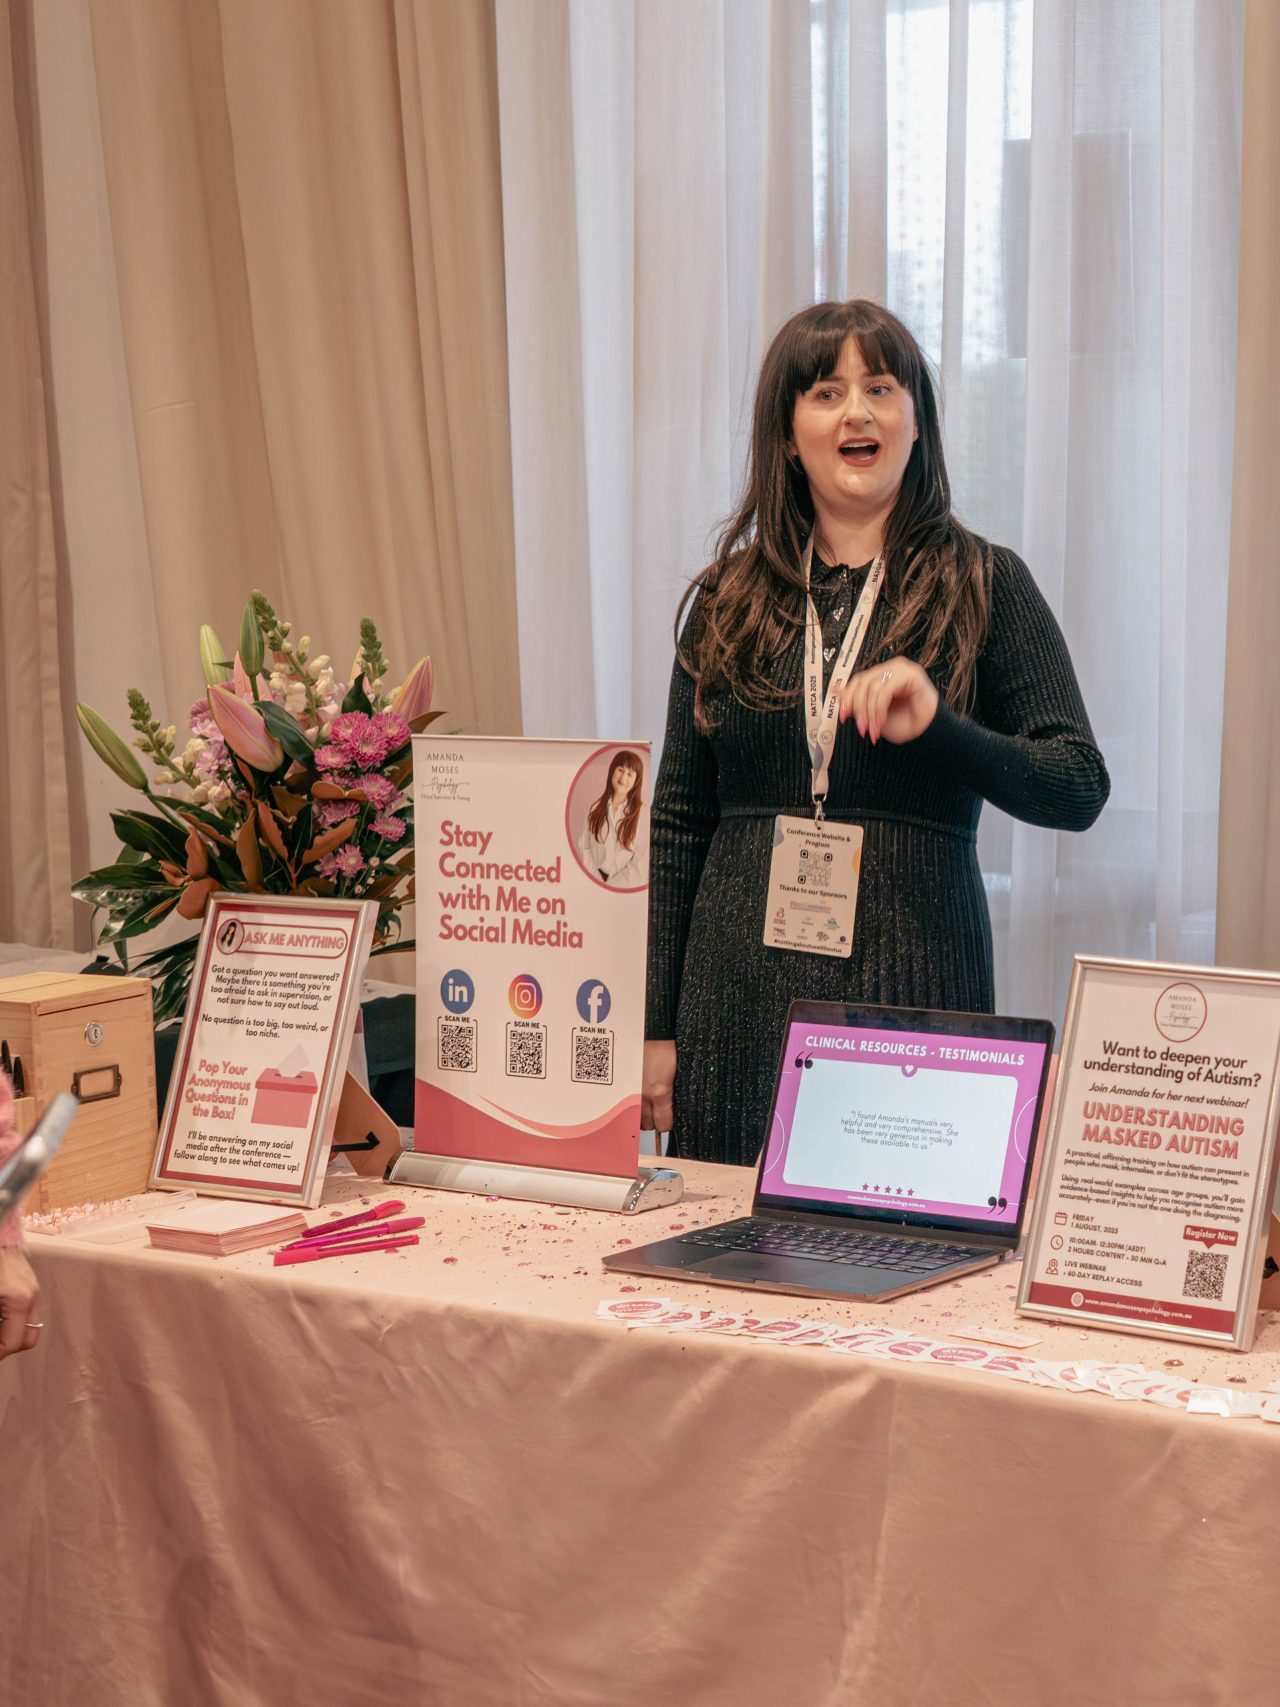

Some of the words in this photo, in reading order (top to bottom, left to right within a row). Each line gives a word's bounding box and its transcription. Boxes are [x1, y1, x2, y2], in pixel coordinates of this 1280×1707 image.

[827, 696, 837, 718] NATCA
[427, 753, 464, 762] AMANDA
[432, 766, 458, 774] MOSES
[439, 820, 493, 855] Stay
[787, 828, 820, 838] Conference
[822, 832, 845, 841] Website
[805, 840, 830, 848] Program
[438, 852, 561, 883] Connected
[438, 884, 490, 911] with
[496, 886, 530, 914] Me
[536, 897, 566, 916] on
[779, 884, 800, 893] Thanks
[820, 890, 848, 900] Sponsors
[438, 914, 506, 944] Social
[512, 918, 583, 948] Media
[244, 931, 268, 945] ASK
[270, 933, 286, 946] ME
[287, 934, 345, 950] ANYTHING
[212, 964, 224, 974] Got
[232, 967, 262, 976] question
[264, 970, 278, 980] you
[280, 970, 298, 978] want
[299, 972, 340, 982] answered?
[216, 975, 240, 986] Maybe
[242, 977, 260, 986] there
[269, 980, 306, 992] something
[307, 982, 331, 992] you're
[448, 978, 468, 1003] in
[210, 986, 222, 994] too
[224, 986, 246, 995] afraid
[248, 988, 255, 996] to
[256, 988, 268, 996] ask
[278, 991, 322, 1001] supervision,
[202, 1014, 212, 1022] No
[214, 1016, 244, 1026] question
[246, 1018, 251, 1026] is
[266, 1019, 280, 1029] big,
[282, 1021, 294, 1029] too
[295, 1022, 318, 1032] weird,
[462, 1016, 470, 1024] ME
[514, 1020, 530, 1028] SCAN
[246, 1028, 258, 1036] too
[259, 1029, 280, 1038] niche.
[580, 1026, 596, 1034] SCAN
[806, 1036, 856, 1051] CLINICAL
[860, 1042, 928, 1058] RESOURCES
[939, 1047, 1025, 1066] TESTIMONIALS
[1102, 1040, 1140, 1058] Want
[1144, 1046, 1156, 1060] to
[1160, 1047, 1210, 1067] deepen
[1214, 1056, 1248, 1070] your
[199, 1059, 219, 1076] Pop
[222, 1060, 248, 1076] Your
[1084, 1058, 1184, 1084] understanding
[1187, 1066, 1202, 1081] of
[1204, 1069, 1262, 1088] Autism?
[188, 1073, 250, 1091] Anonymous
[185, 1088, 236, 1106] Questions
[238, 1094, 248, 1106] in
[1088, 1082, 1108, 1094] Join
[1109, 1085, 1150, 1098] Amanda
[1152, 1090, 1166, 1100] for
[1167, 1090, 1182, 1101] her
[1184, 1094, 1204, 1103] next
[1206, 1097, 1249, 1108] webinar!
[192, 1104, 208, 1117] the
[211, 1106, 236, 1120] Box!
[1082, 1101, 1244, 1136] UNDERSTANDING
[188, 1130, 197, 1139] I'll
[198, 1132, 207, 1140] be
[208, 1135, 246, 1146] answering
[259, 1140, 271, 1148] my
[272, 1141, 294, 1150] social
[1082, 1123, 1162, 1150] MASKED
[1165, 1134, 1239, 1159] AUTISM
[186, 1142, 208, 1151] media
[210, 1144, 228, 1152] after
[229, 1146, 240, 1154] the
[242, 1148, 282, 1159] conference
[174, 1150, 196, 1159] follow
[198, 1152, 218, 1164] along
[242, 1158, 261, 1168] what
[262, 1162, 285, 1170] comes
[287, 1163, 300, 1172] up!
[1072, 1214, 1094, 1222] FRIDAY
[1104, 1226, 1118, 1234] 2025
[1186, 1228, 1217, 1240] Register
[1218, 1232, 1236, 1242] Now
[1100, 1241, 1124, 1250] 12:30PM
[1126, 1244, 1146, 1254] (AEDT)
[1064, 1260, 1078, 1268] LIVE
[1079, 1262, 1106, 1272] WEBINAR
[1068, 1270, 1090, 1280] 60-DAY
[1092, 1274, 1114, 1283] REPLAY
[1116, 1277, 1142, 1286] ACCESS
